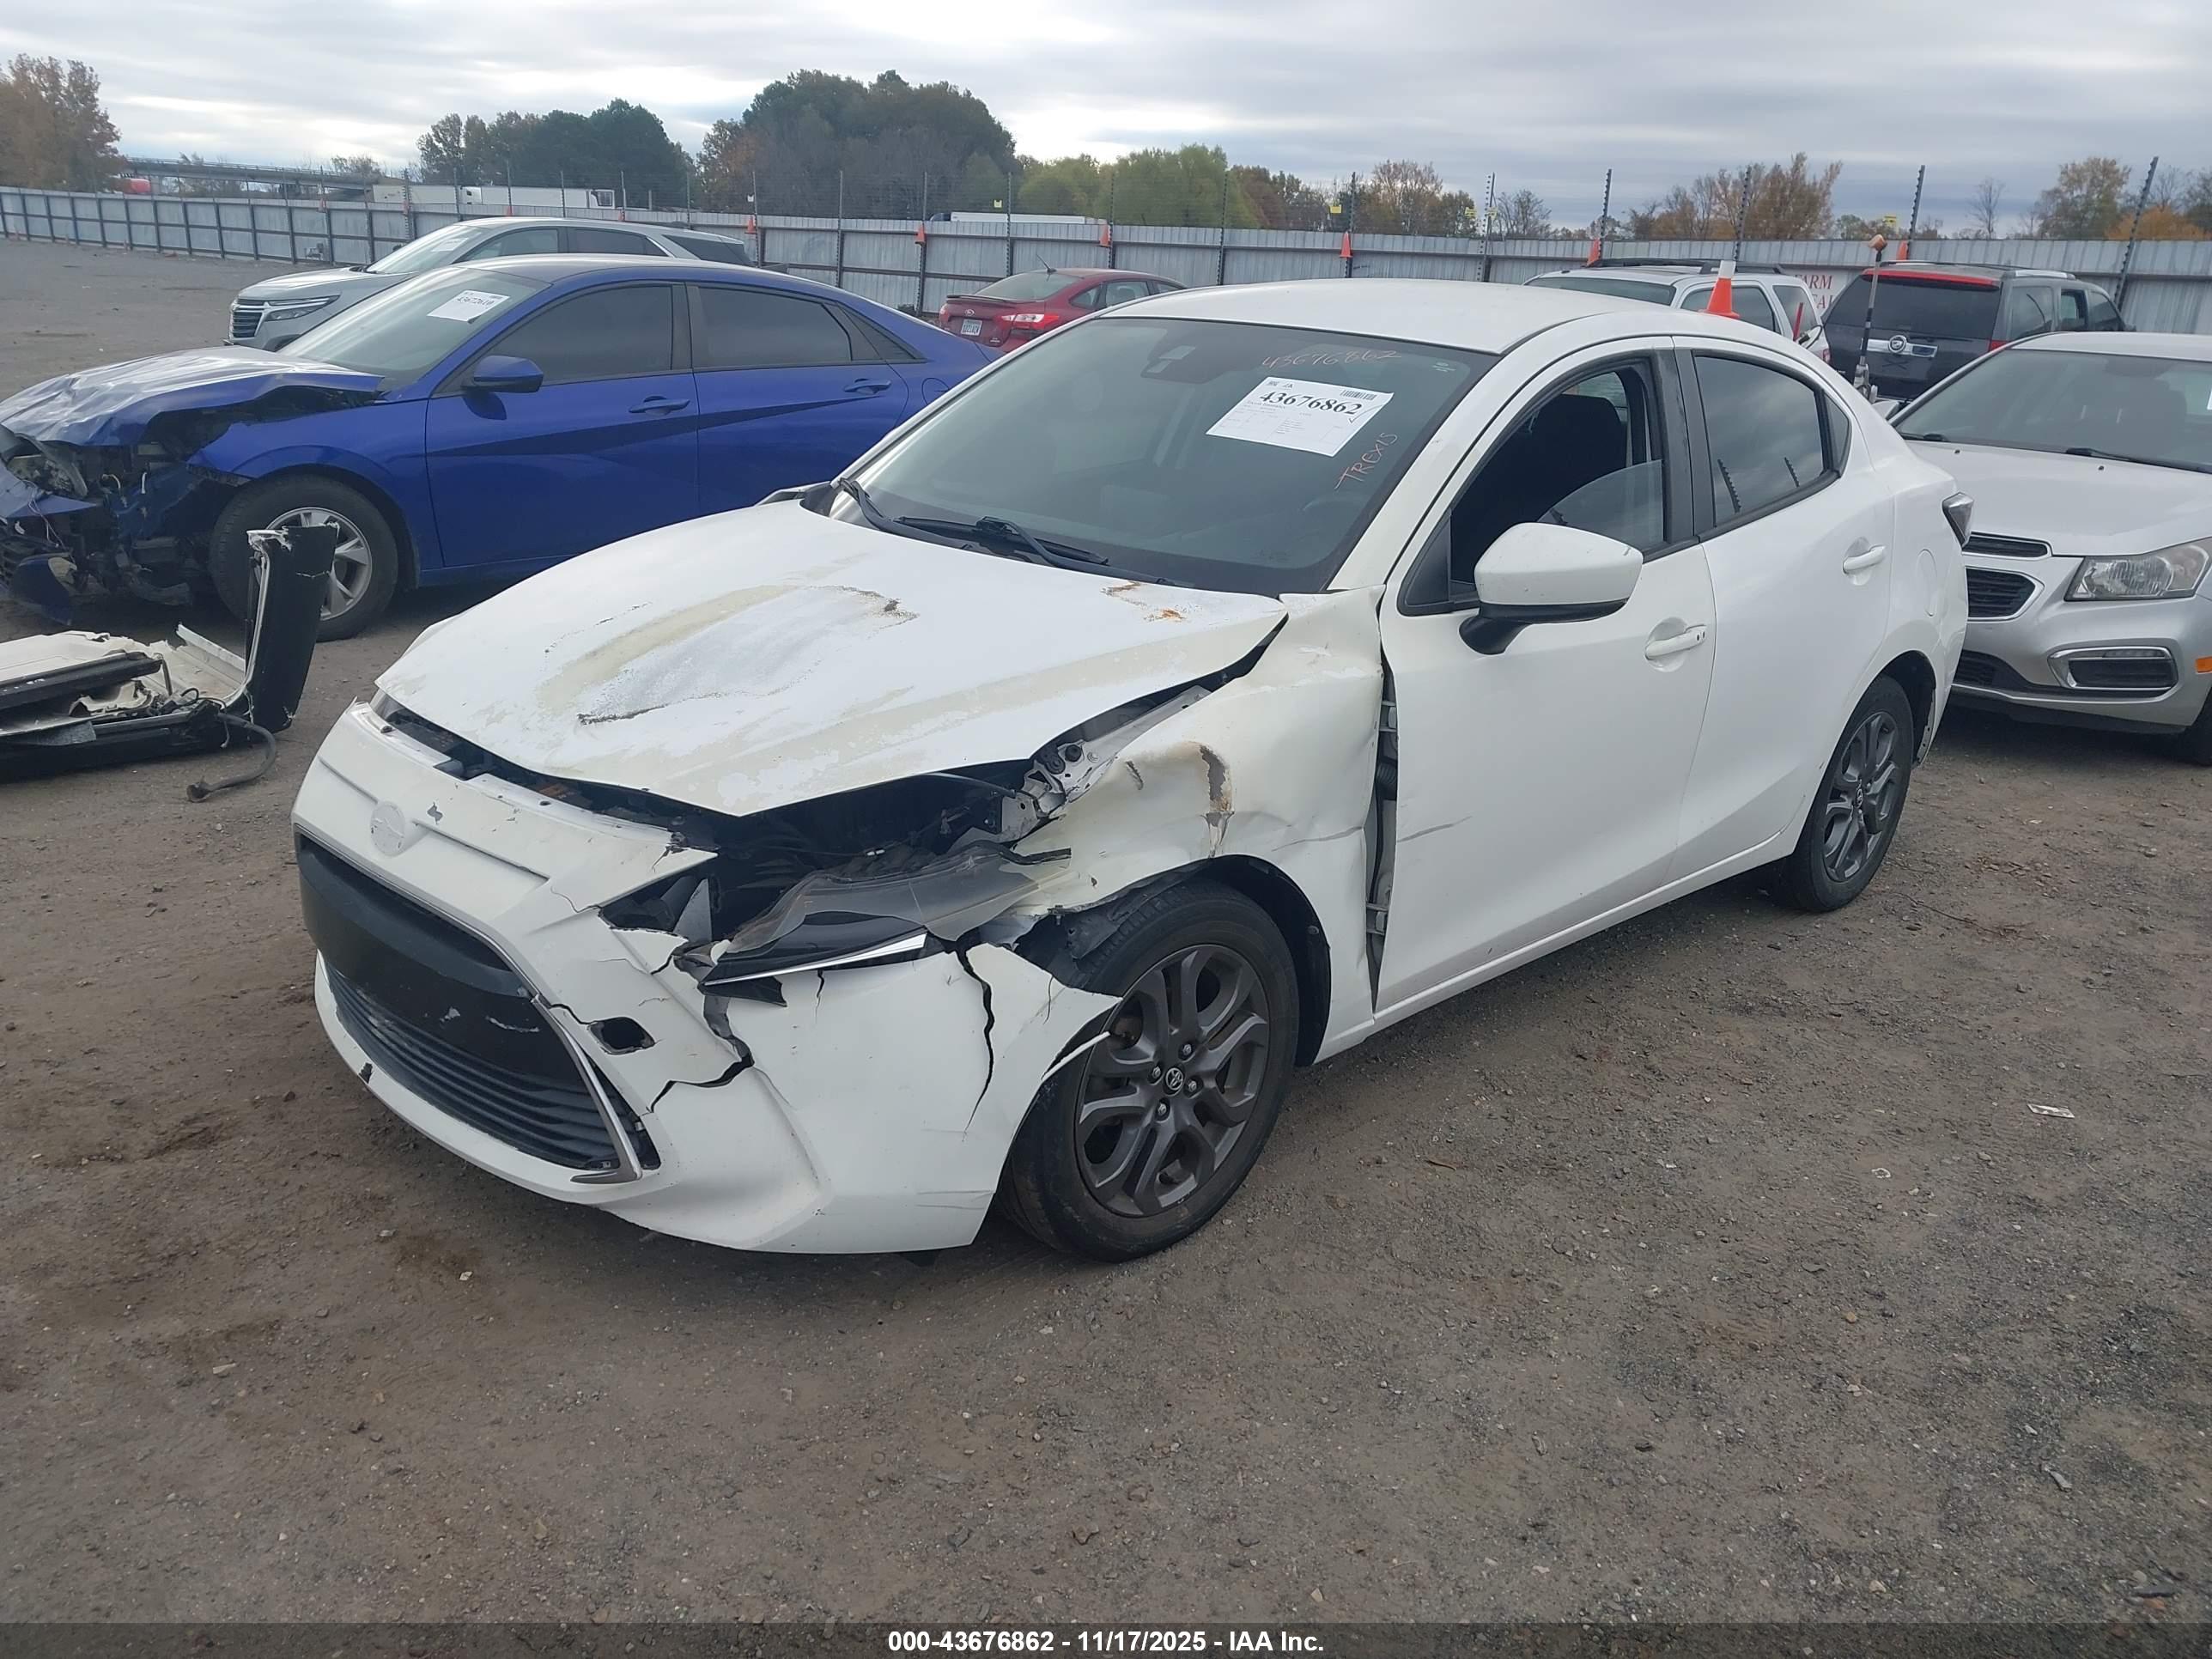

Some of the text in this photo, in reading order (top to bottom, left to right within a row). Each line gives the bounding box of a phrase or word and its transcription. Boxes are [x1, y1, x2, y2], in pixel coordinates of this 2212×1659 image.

[1796, 274, 1833, 289] ARM
[1262, 350, 1401, 368] 43676862
[1260, 392, 1363, 415] 43676862
